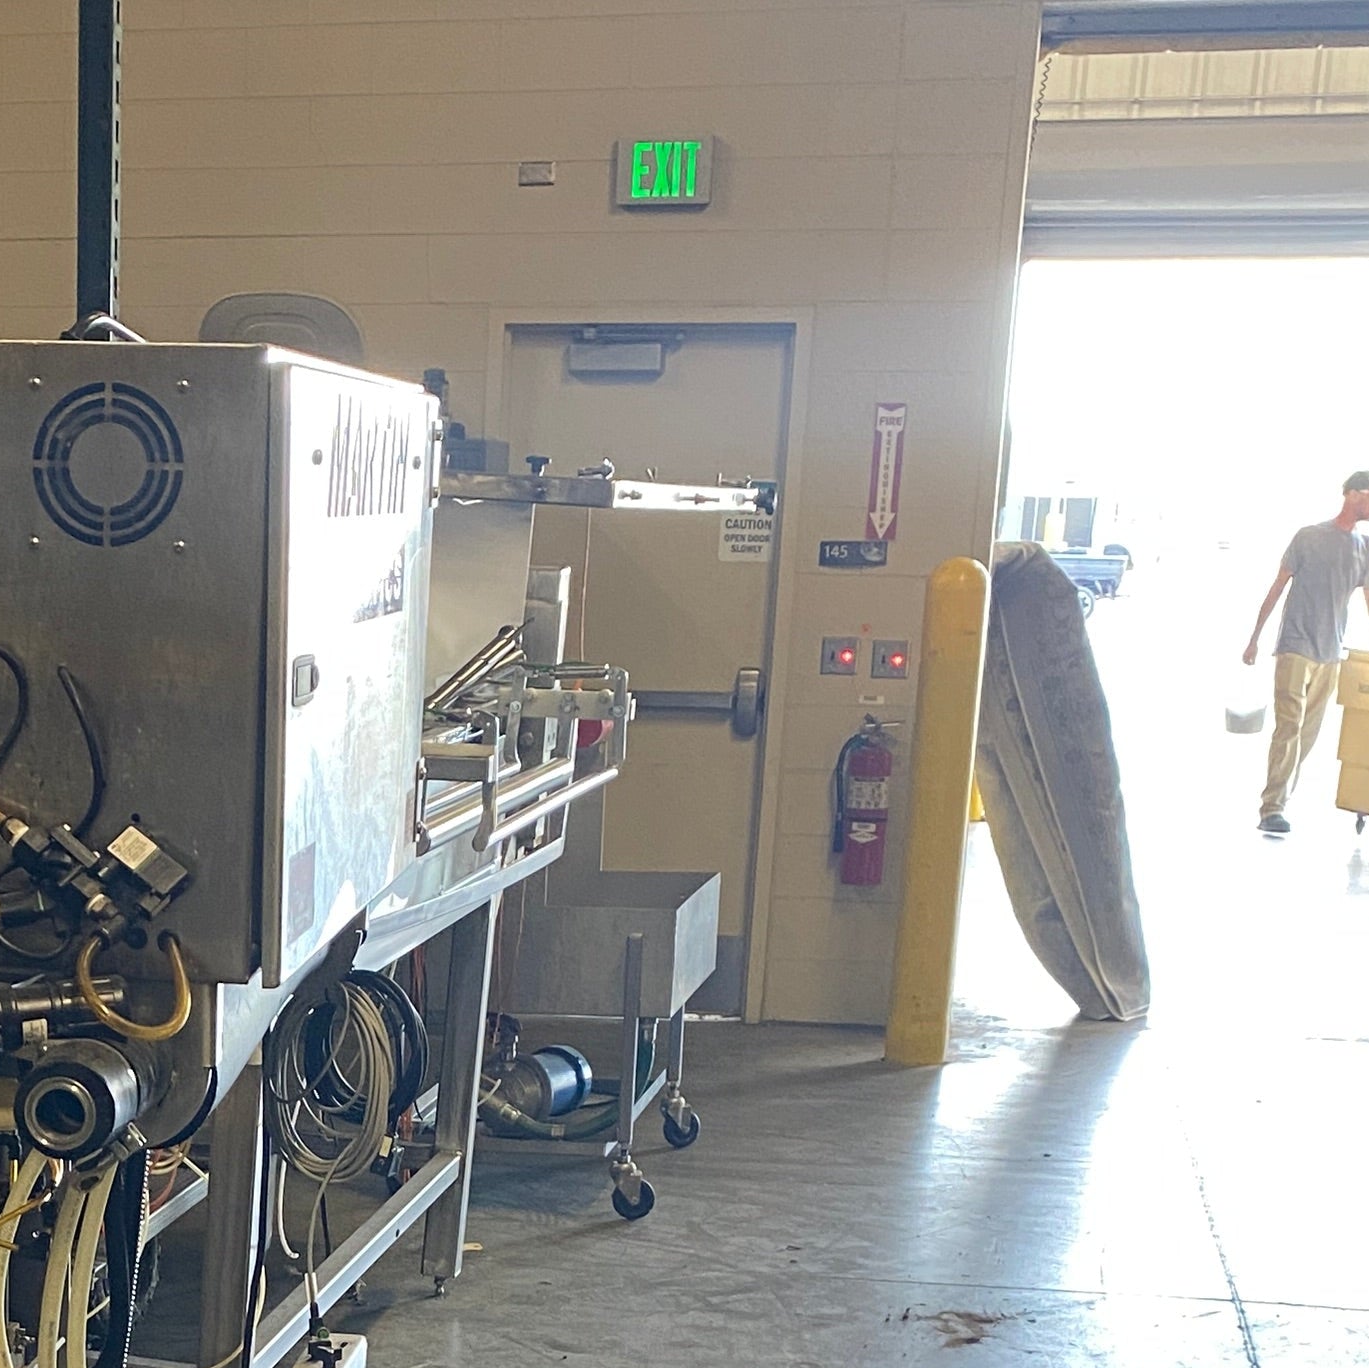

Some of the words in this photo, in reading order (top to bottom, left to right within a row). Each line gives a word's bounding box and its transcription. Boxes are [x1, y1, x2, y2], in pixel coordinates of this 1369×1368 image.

[631, 141, 702, 198] EXIT
[879, 416, 903, 426] FIRE
[725, 518, 772, 530] CAUTION
[724, 533, 746, 543] OPEN
[747, 534, 770, 543] DOOR
[731, 544, 763, 553] SLOWLY
[824, 544, 849, 559] 145
